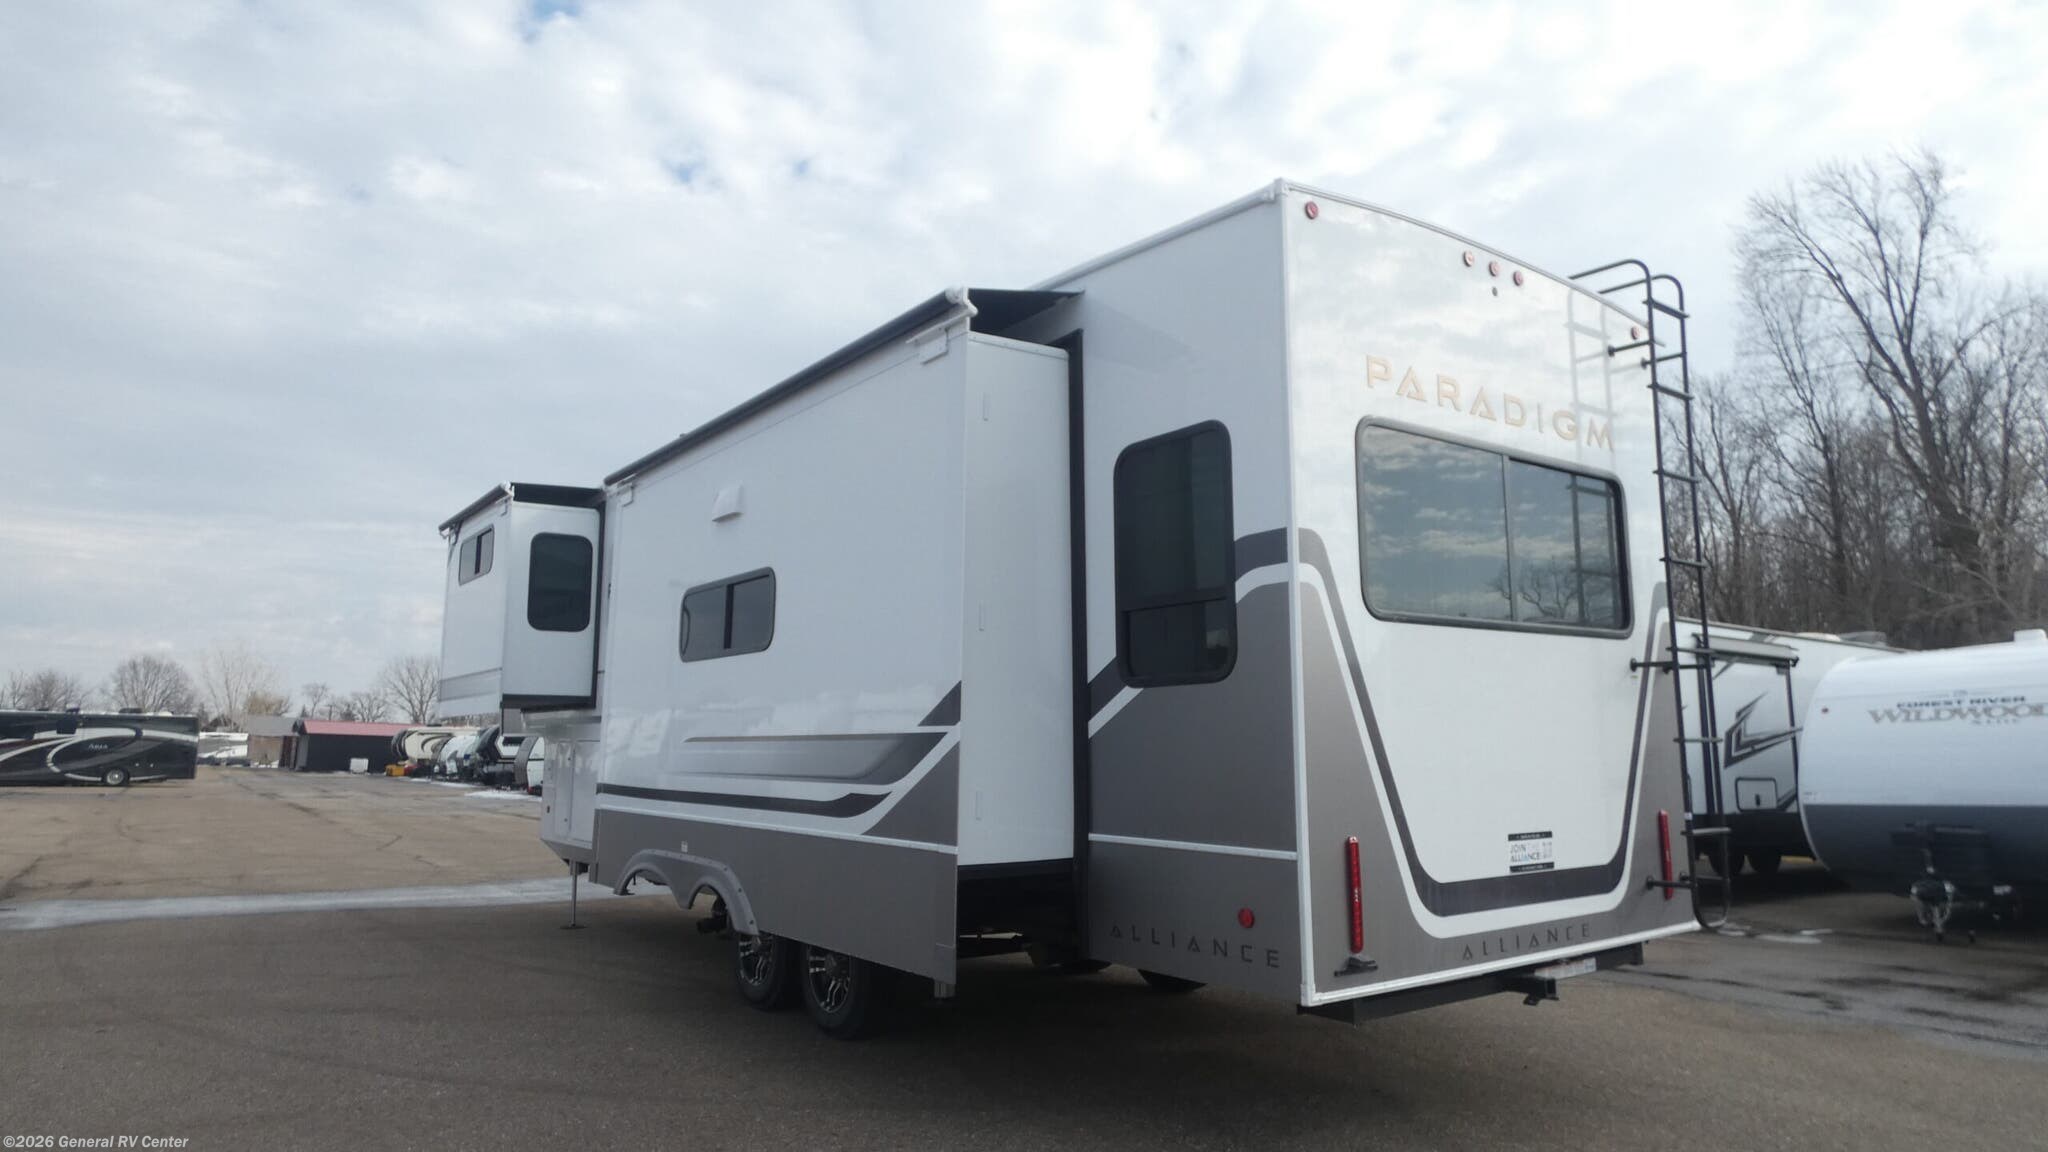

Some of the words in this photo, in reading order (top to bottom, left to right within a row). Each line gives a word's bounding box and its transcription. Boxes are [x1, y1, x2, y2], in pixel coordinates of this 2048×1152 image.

[1366, 355, 1615, 452] PARADIGM
[1110, 924, 1281, 969] ALLIANCE
[1462, 922, 1591, 961] ALLIANCE
